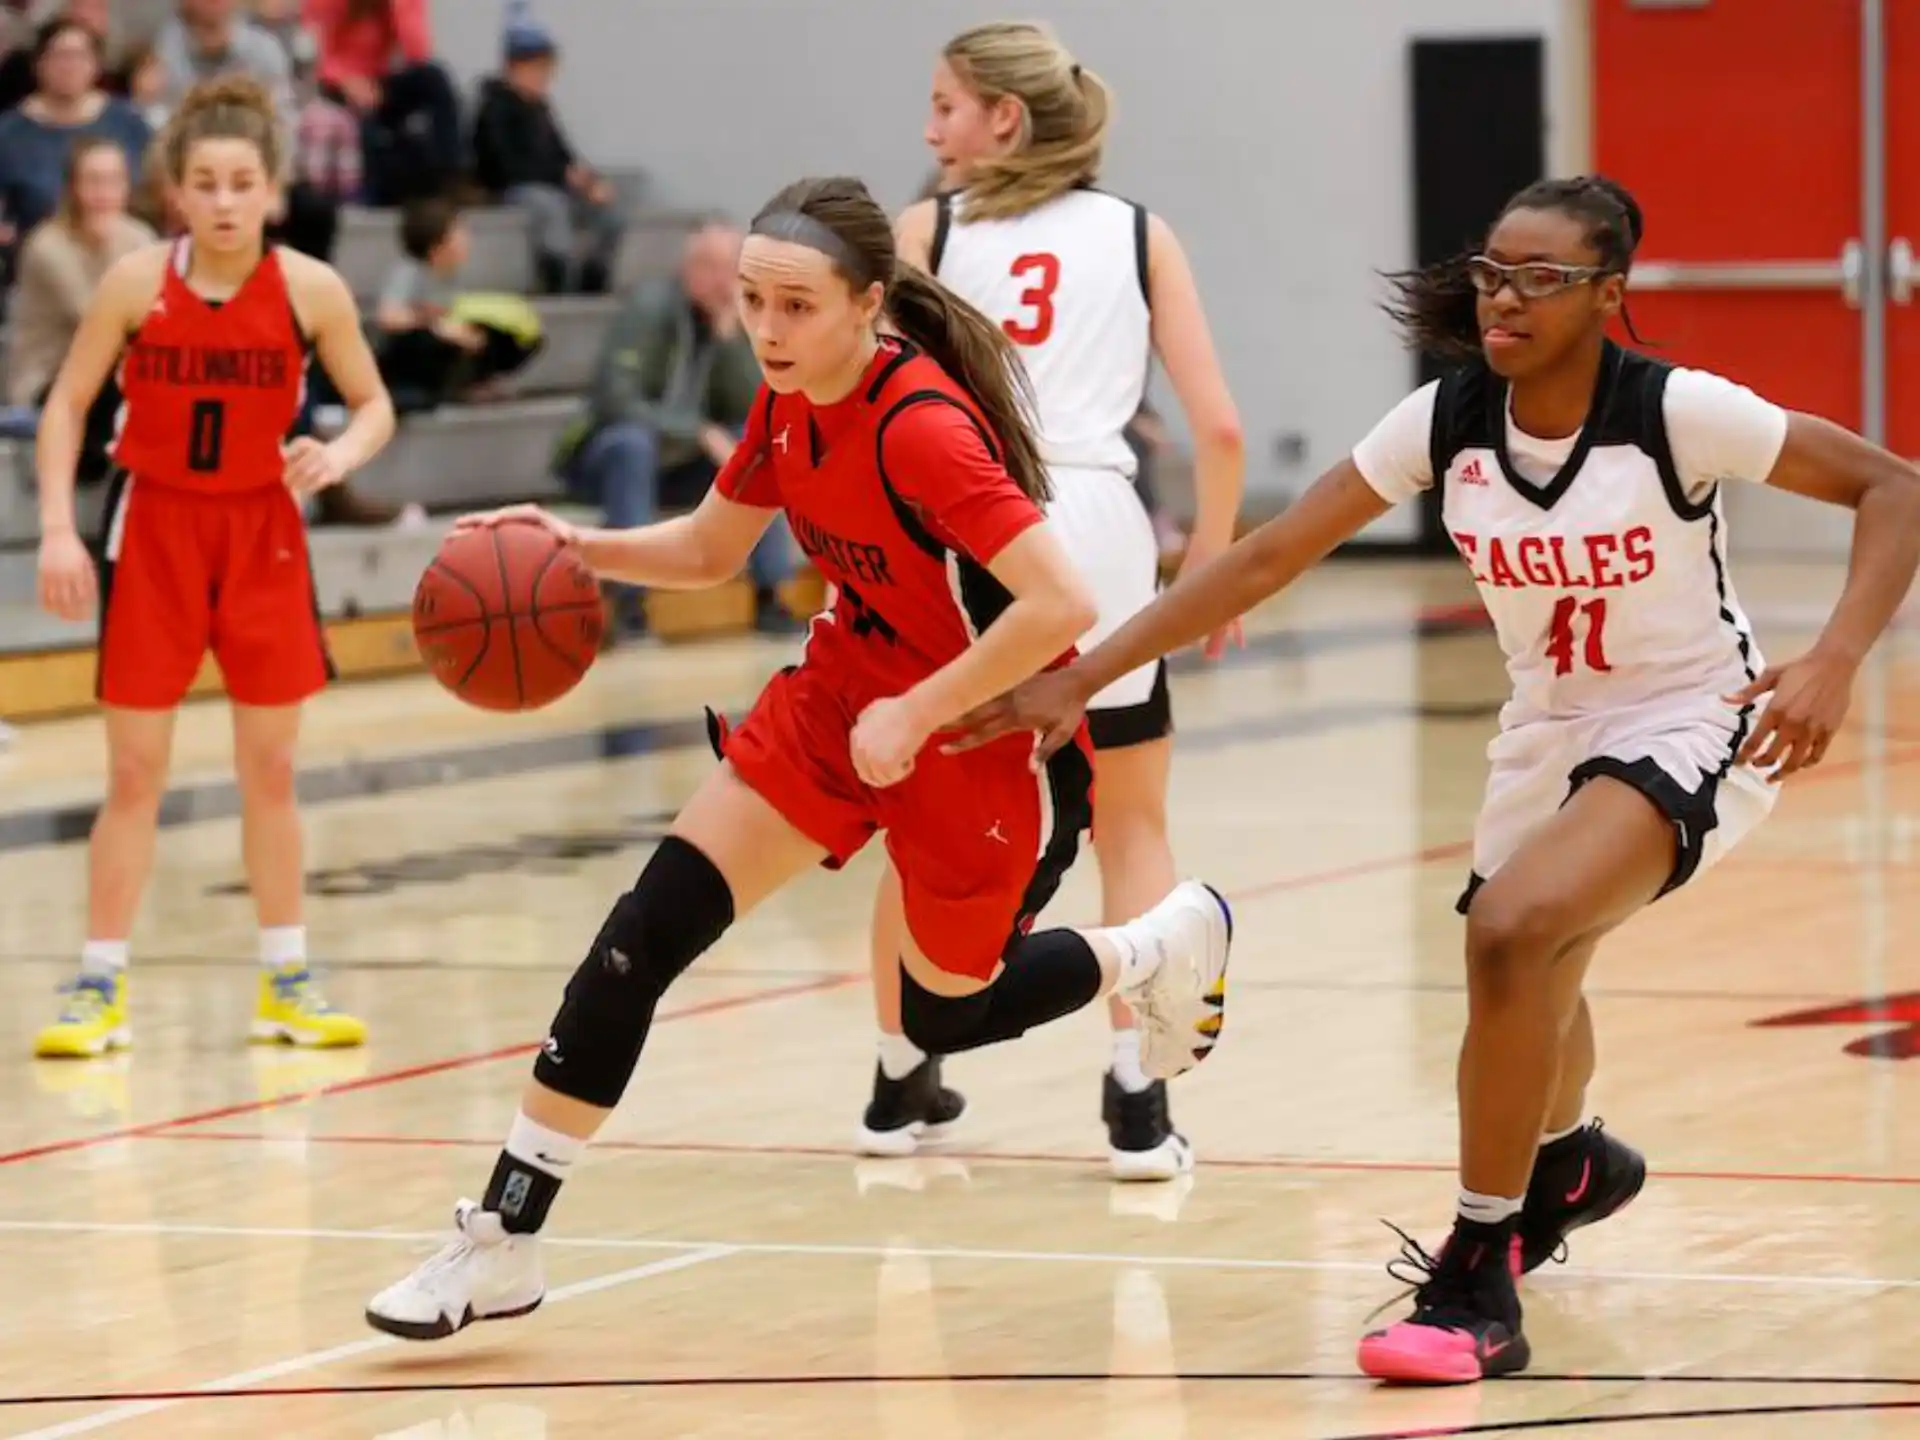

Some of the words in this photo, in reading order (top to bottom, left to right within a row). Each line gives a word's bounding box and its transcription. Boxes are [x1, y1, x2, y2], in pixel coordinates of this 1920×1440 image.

[1003, 253, 1059, 346] 3
[189, 399, 223, 471] 0
[1453, 526, 1655, 589] EAGLES
[1545, 596, 1612, 677] 41
